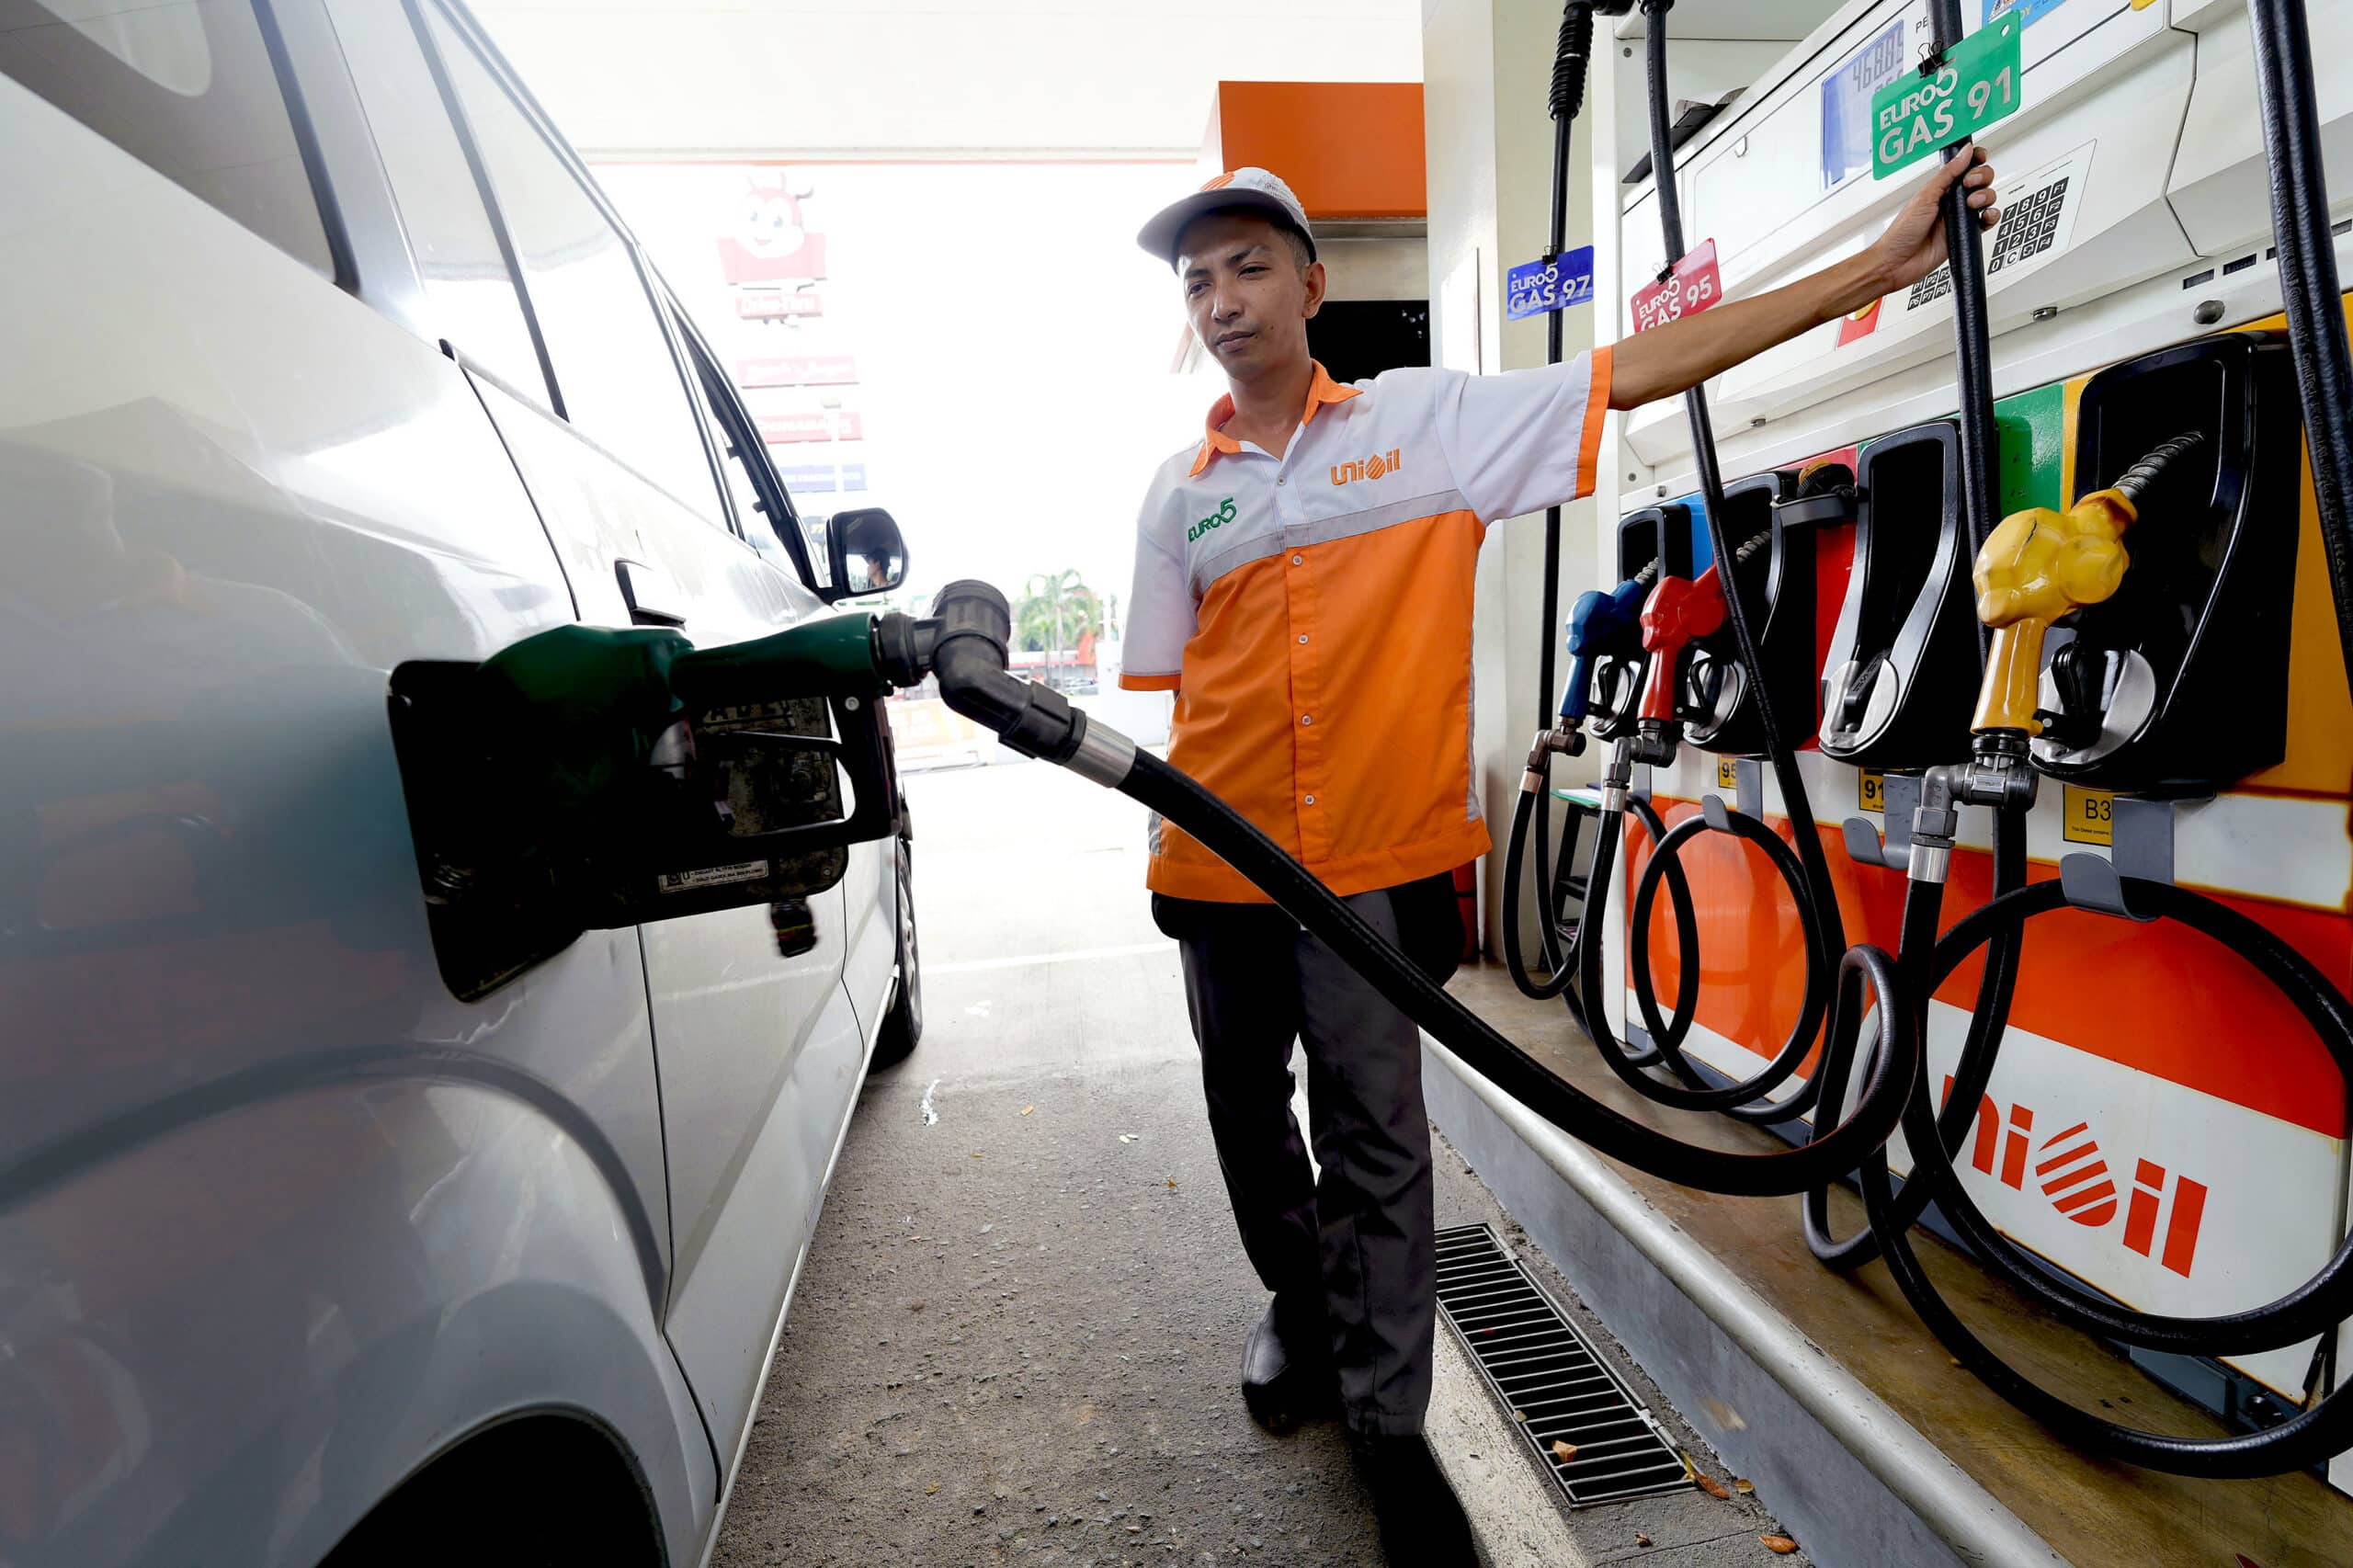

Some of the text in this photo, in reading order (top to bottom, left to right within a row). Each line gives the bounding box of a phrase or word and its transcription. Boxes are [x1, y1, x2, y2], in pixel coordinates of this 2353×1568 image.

[1880, 57, 1958, 131] EURO5
[1879, 98, 1954, 165] GAS
[1967, 65, 2011, 120] 91
[2001, 201, 2061, 235] 4 5 6 F2
[2006, 183, 2064, 219] 7 8 9 F1
[2012, 234, 2020, 246] 2
[2029, 226, 2038, 239] 3
[2044, 220, 2056, 231] F3
[1511, 261, 1559, 292] EURO5
[1992, 261, 2000, 272] 0
[2007, 252, 2017, 265] C
[1510, 275, 1590, 313] GAS 97
[1639, 272, 1680, 319] EURO5
[1640, 274, 1712, 332] GAS 95
[1188, 496, 1237, 543] EURO5
[2086, 798, 2111, 821] B3
